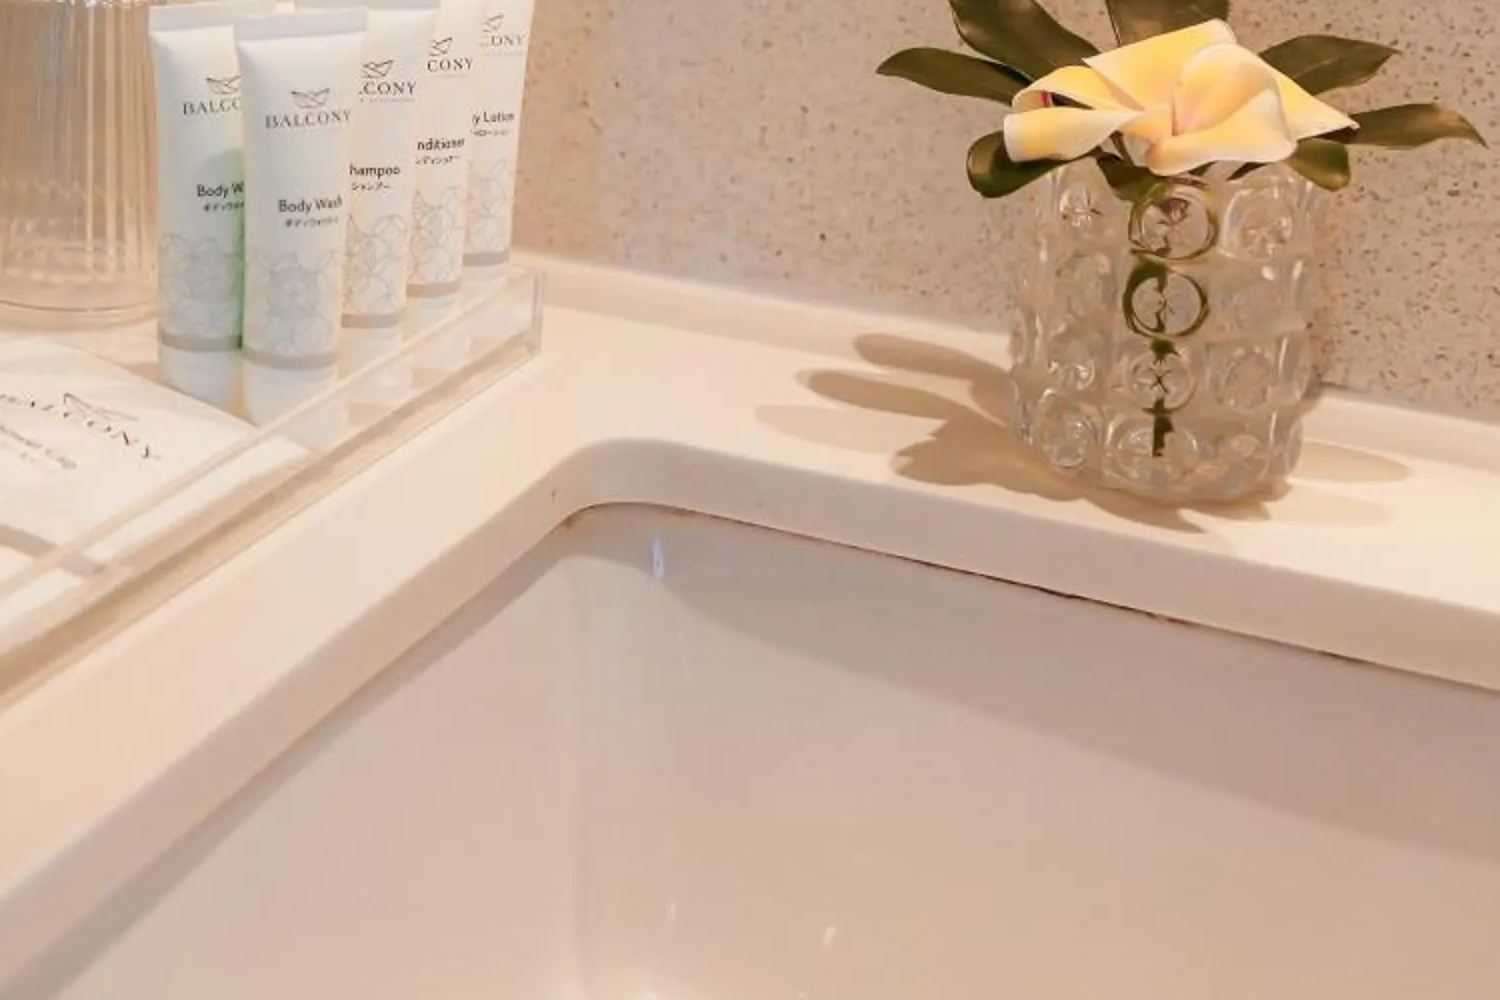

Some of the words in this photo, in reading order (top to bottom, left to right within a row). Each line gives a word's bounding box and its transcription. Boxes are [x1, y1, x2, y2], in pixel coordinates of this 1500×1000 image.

[427, 58, 473, 73] CONY
[358, 81, 417, 96] CONY
[182, 97, 241, 116] BALCO
[265, 109, 351, 129] BALCONY
[417, 136, 466, 152] nditioner
[349, 163, 402, 180] hampoo
[196, 183, 229, 199] Body
[278, 198, 313, 214] Body
